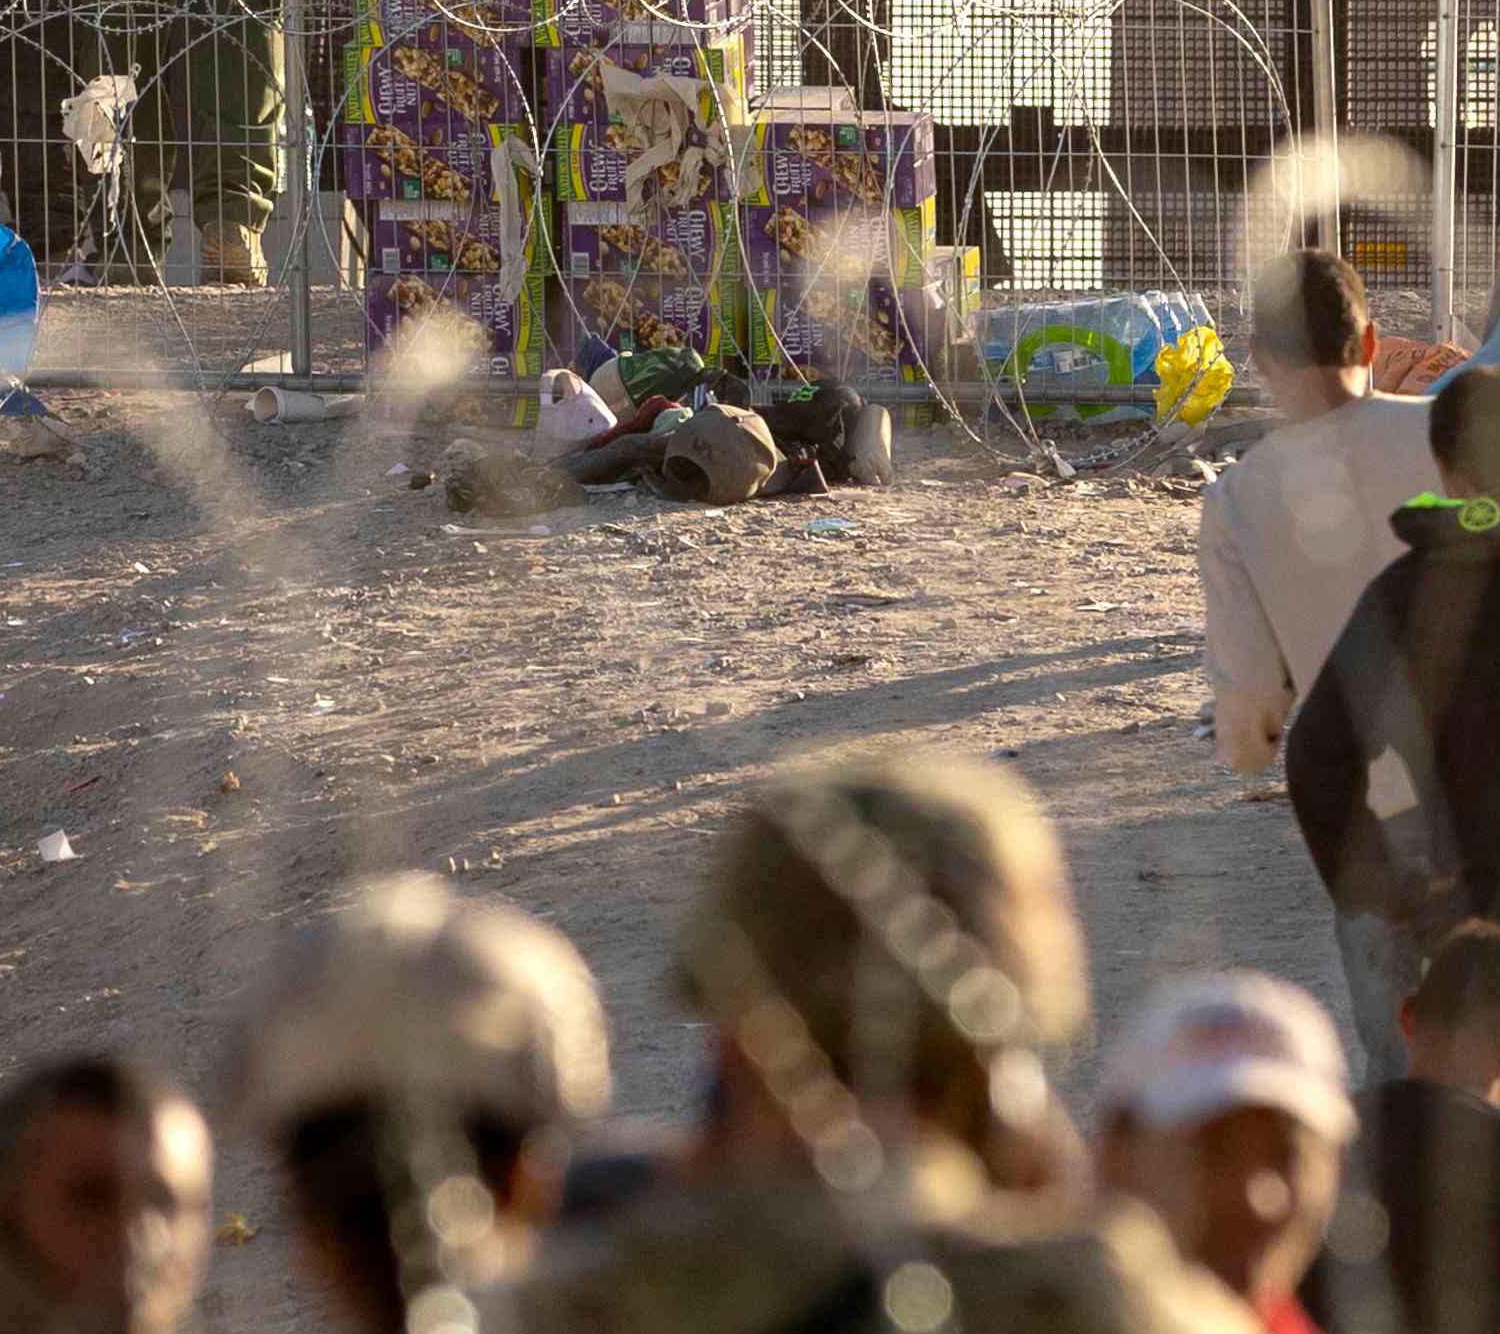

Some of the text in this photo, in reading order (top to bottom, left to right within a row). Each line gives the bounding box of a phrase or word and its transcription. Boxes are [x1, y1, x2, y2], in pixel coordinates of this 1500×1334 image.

[377, 62, 396, 115] CHEWY
[395, 81, 407, 114] FRUIT
[407, 80, 418, 107] NUT
[457, 132, 470, 165] FRUIT
[588, 139, 608, 192] CHEWY
[607, 158, 619, 192] FRUIT
[775, 146, 793, 196] CHEWY
[791, 162, 803, 194] FRUIT
[802, 160, 813, 186] NUT
[479, 212, 489, 238] NUT
[666, 218, 678, 244] NUT
[678, 210, 690, 243] FRUIT
[689, 210, 707, 263] CHEWY
[471, 292, 483, 317] NUT
[482, 283, 495, 316] FRUIT
[663, 294, 674, 319] NUT
[674, 286, 685, 319] FRUIT
[685, 286, 704, 339] CHEWY
[785, 304, 803, 357] CHEWY
[811, 322, 824, 348] NUT
